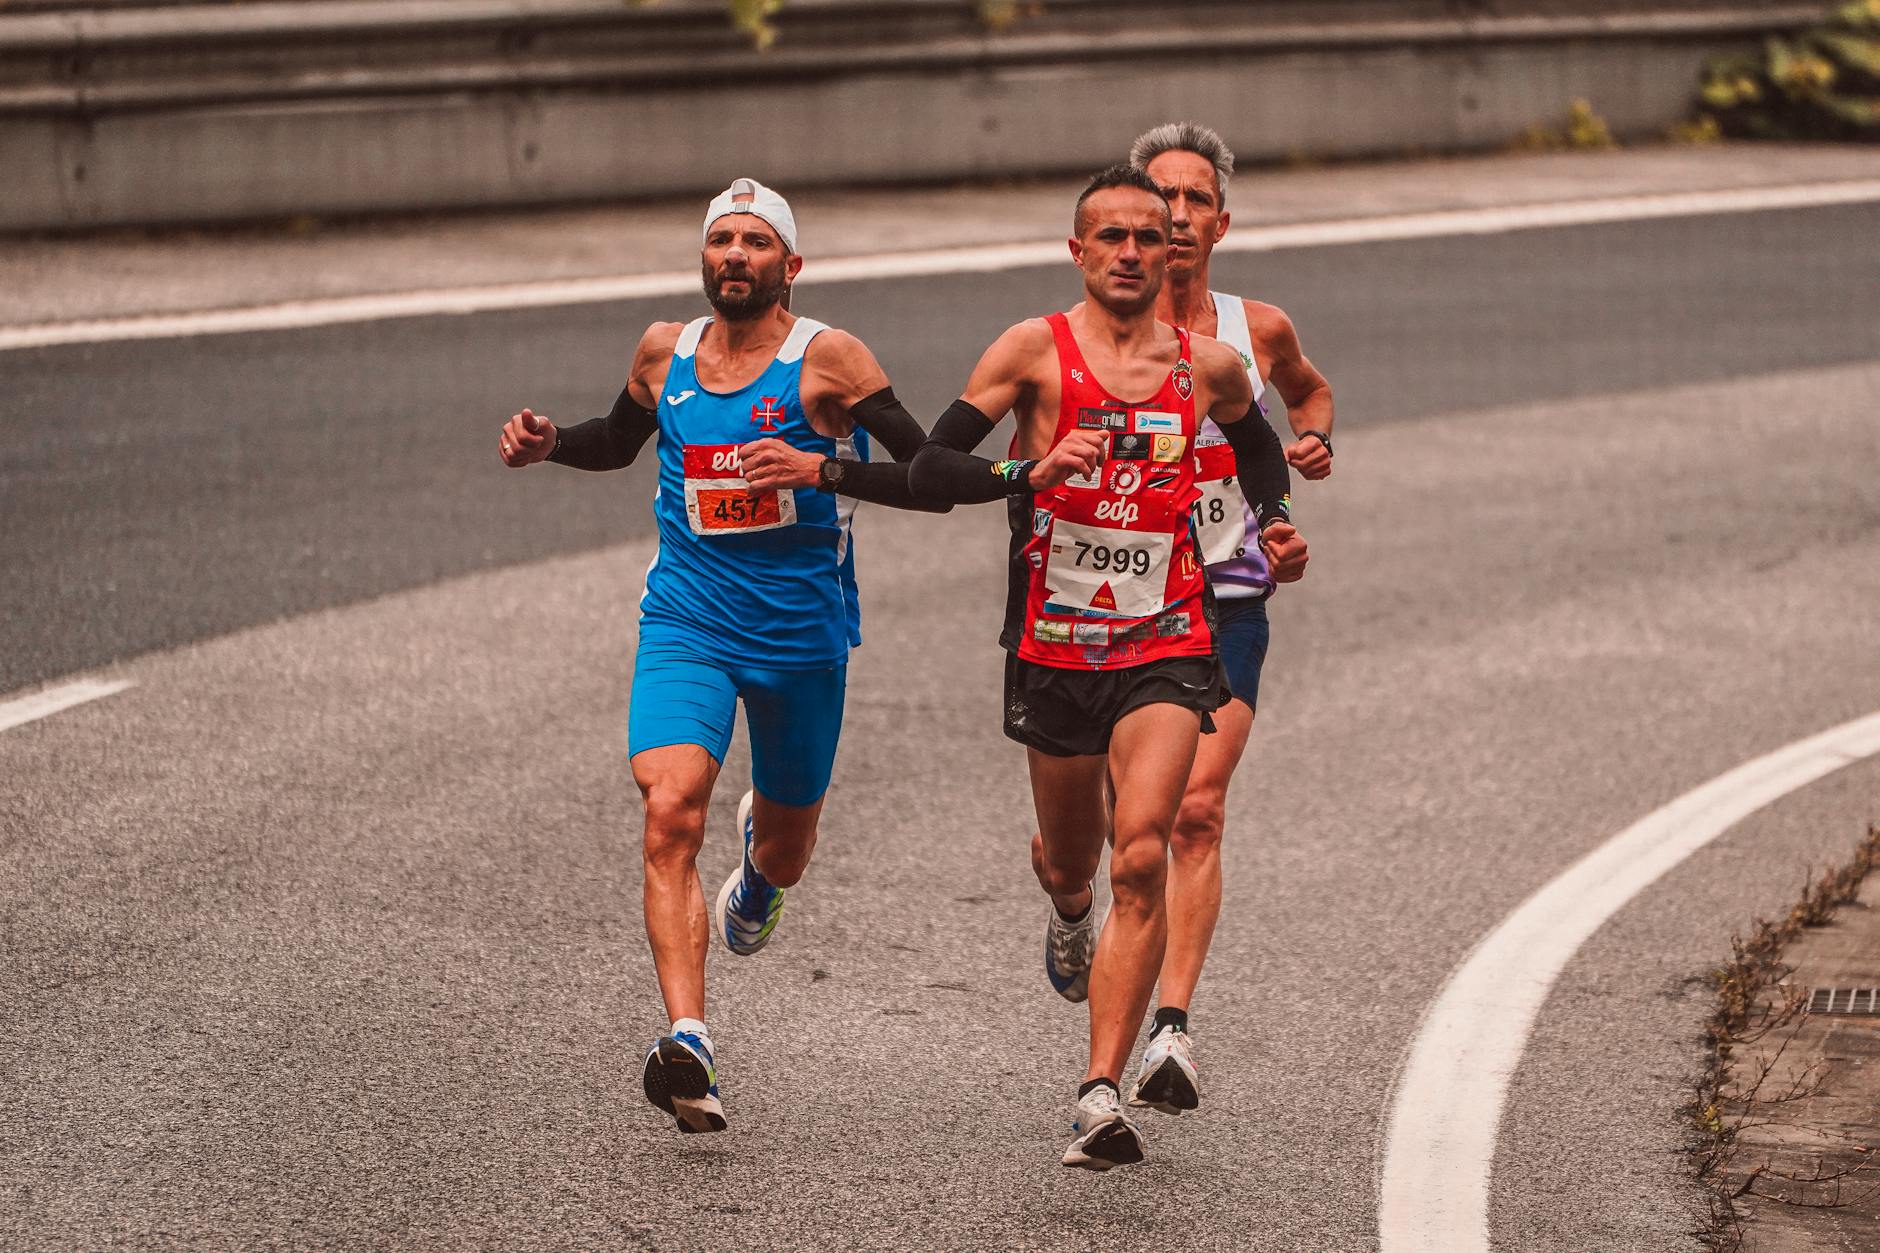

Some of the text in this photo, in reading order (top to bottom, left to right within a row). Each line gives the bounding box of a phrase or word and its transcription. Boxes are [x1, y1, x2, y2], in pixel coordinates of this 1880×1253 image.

[714, 498, 760, 521] 457
[1094, 495, 1139, 528] edp
[1074, 541, 1150, 576] 7999
[1094, 596, 1113, 605] DELTA
